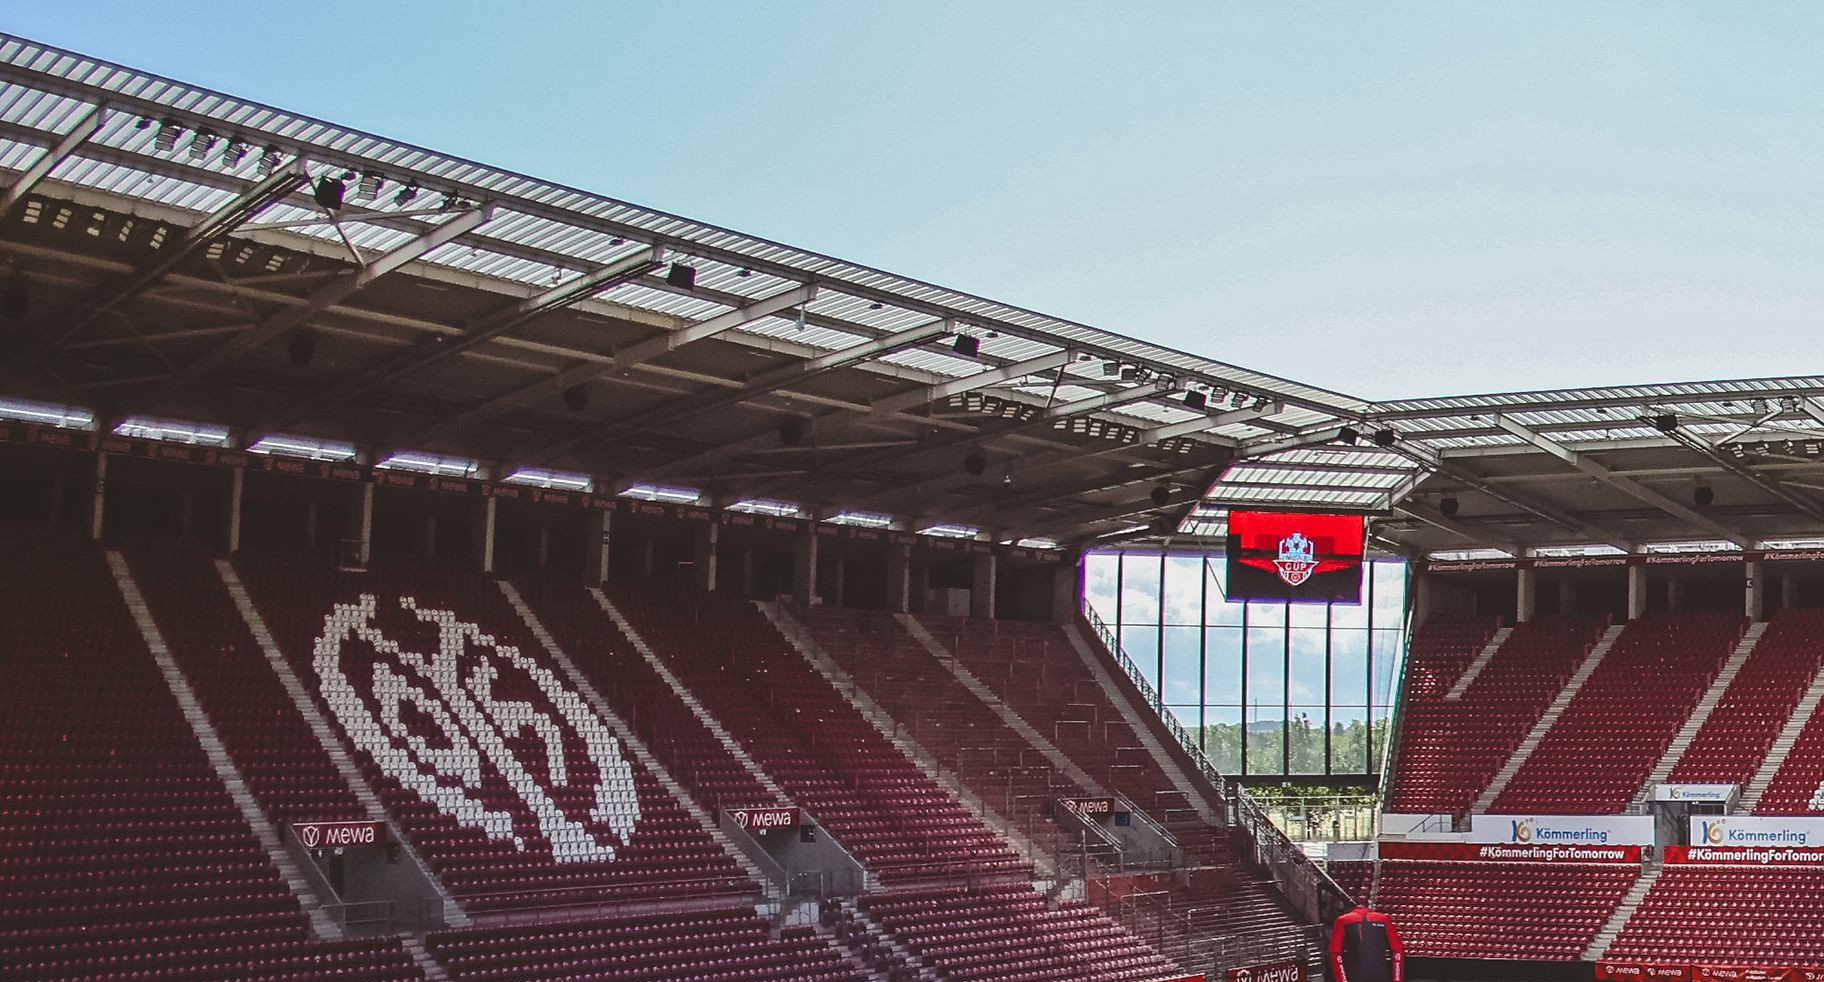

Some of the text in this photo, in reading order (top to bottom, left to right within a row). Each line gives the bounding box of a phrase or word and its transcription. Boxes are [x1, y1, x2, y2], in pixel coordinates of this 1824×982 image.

[1285, 563, 1307, 571] CUP
[1536, 827, 1607, 842] Kömmerling
[1729, 828, 1806, 845] Kömmerling
[1479, 847, 1624, 861] #KömmerlingForTomorrow
